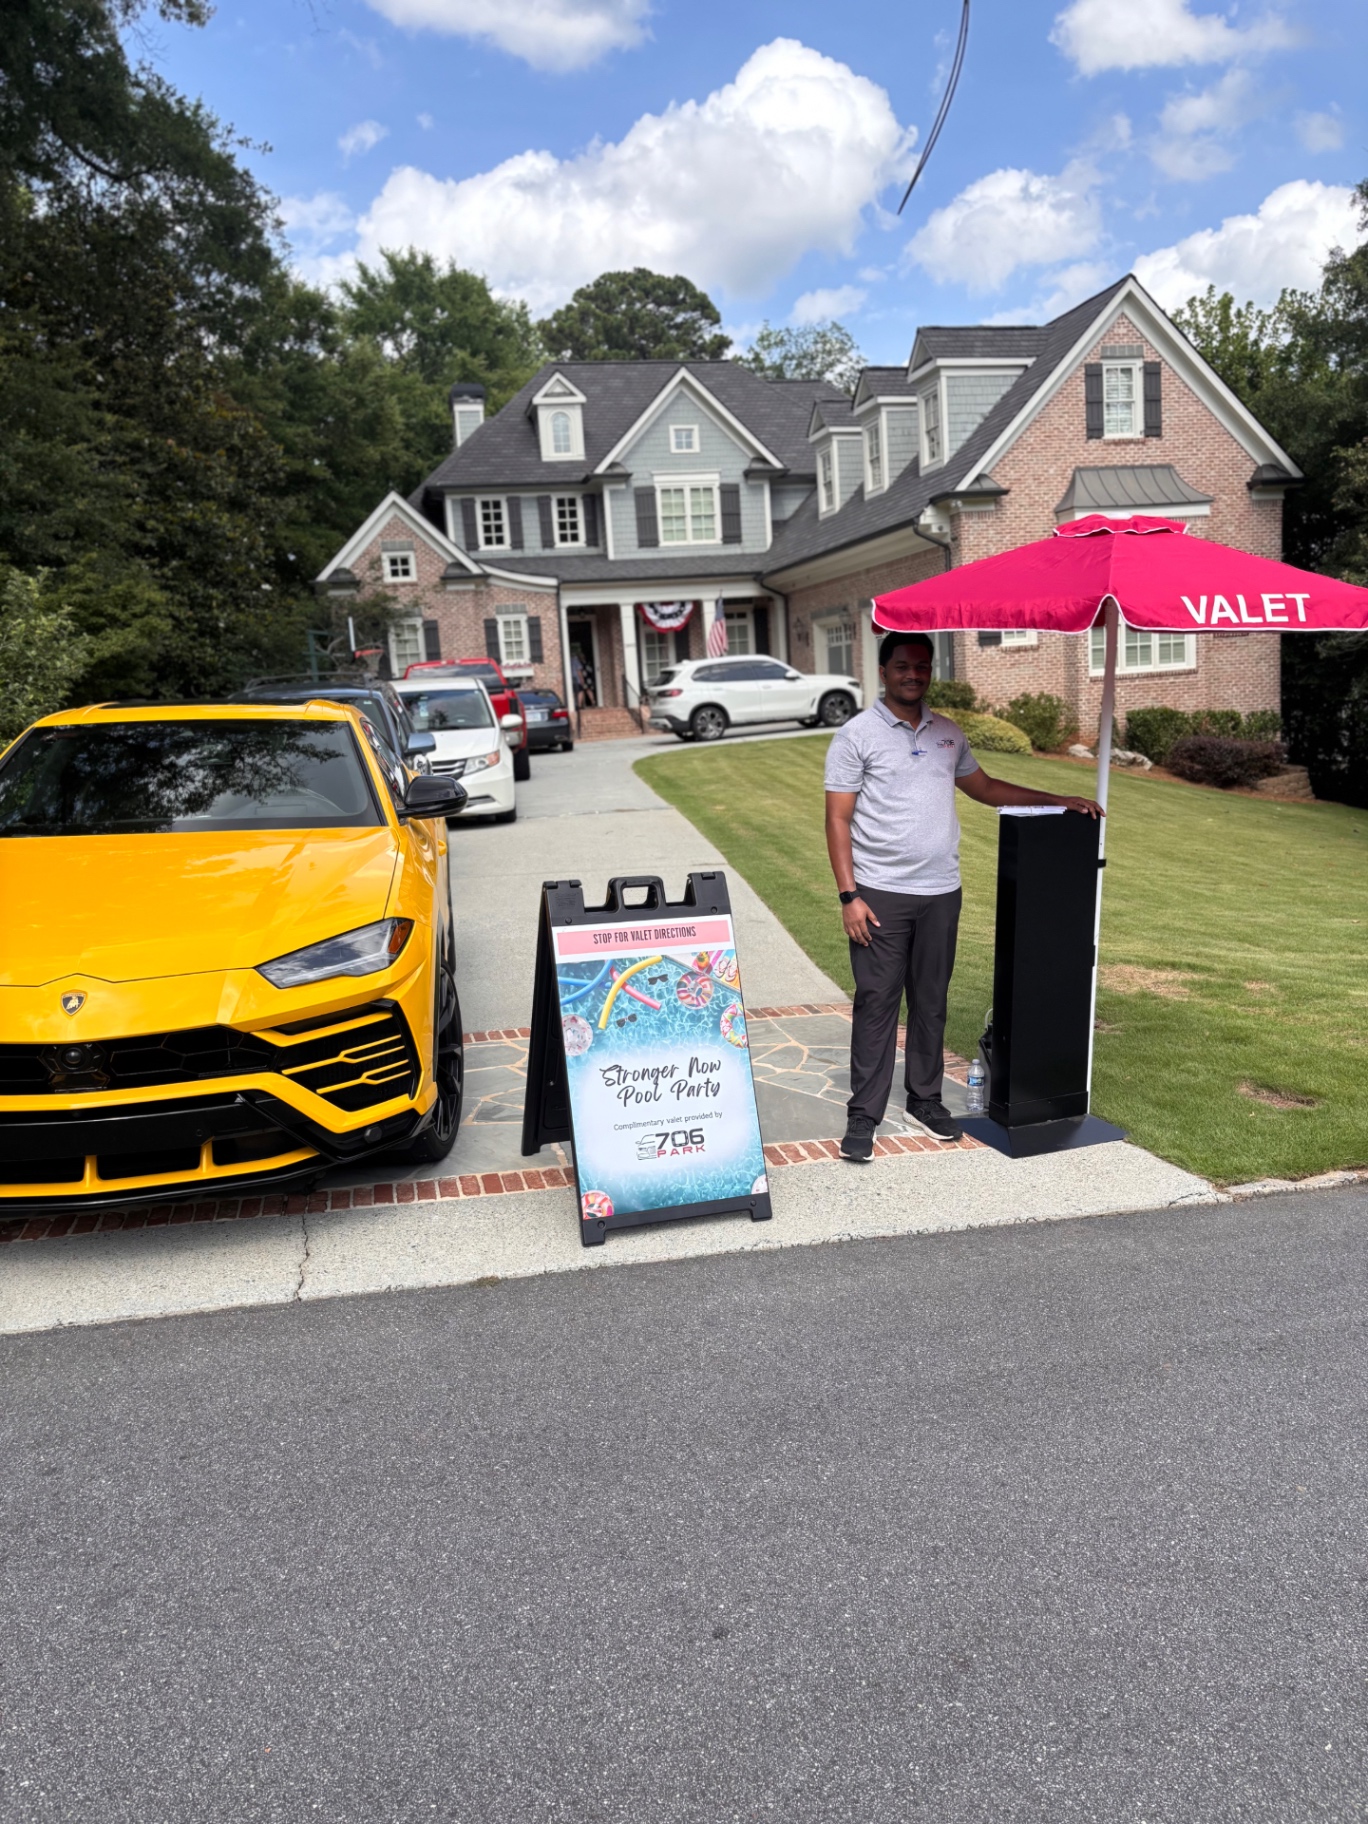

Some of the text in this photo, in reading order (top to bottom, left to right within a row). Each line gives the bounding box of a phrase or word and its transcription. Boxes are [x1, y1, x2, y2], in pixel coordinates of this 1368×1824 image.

[1180, 593, 1310, 624] VALET
[593, 926, 697, 944] STOP FOR VALET DIRECTIONS
[599, 1056, 721, 1087] Stronger Now
[617, 1078, 720, 1107] Pool Party
[613, 1110, 723, 1131] Complimentary valet provided by
[655, 1127, 705, 1150] 706
[657, 1144, 706, 1158] PARK
